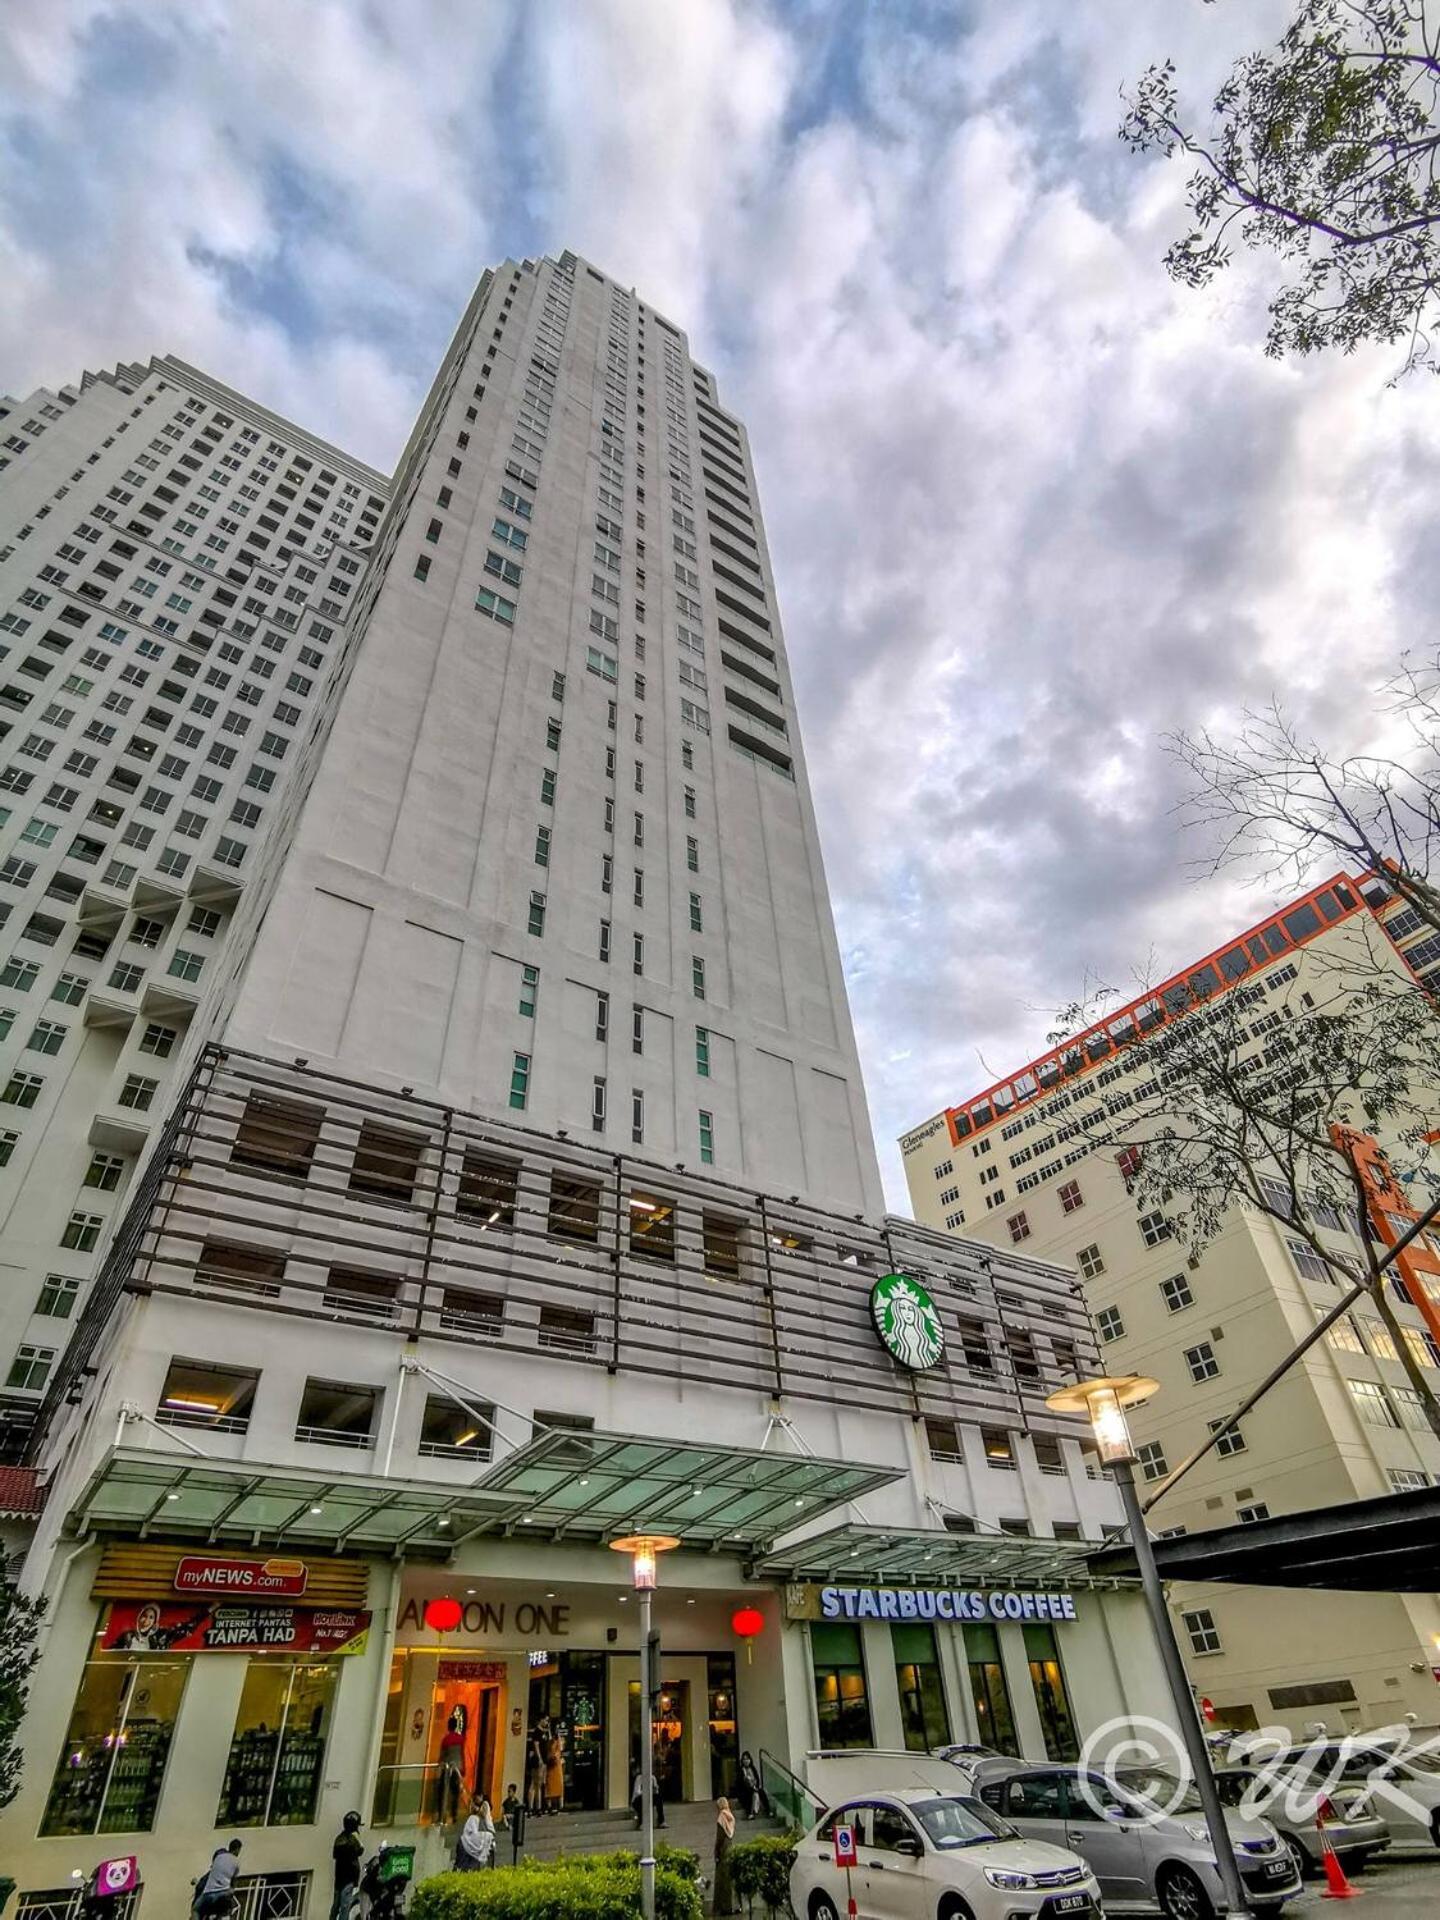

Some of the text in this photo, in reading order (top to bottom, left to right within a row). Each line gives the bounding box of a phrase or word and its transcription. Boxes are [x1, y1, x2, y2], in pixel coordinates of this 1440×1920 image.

[821, 1586, 985, 1619] STARBUCKS
[989, 1591, 1076, 1619] COFFEE
[216, 1619, 291, 1628] INTERNET PANTAS
[515, 1603, 570, 1635] ONE
[207, 1628, 296, 1644] TANPA HAD
